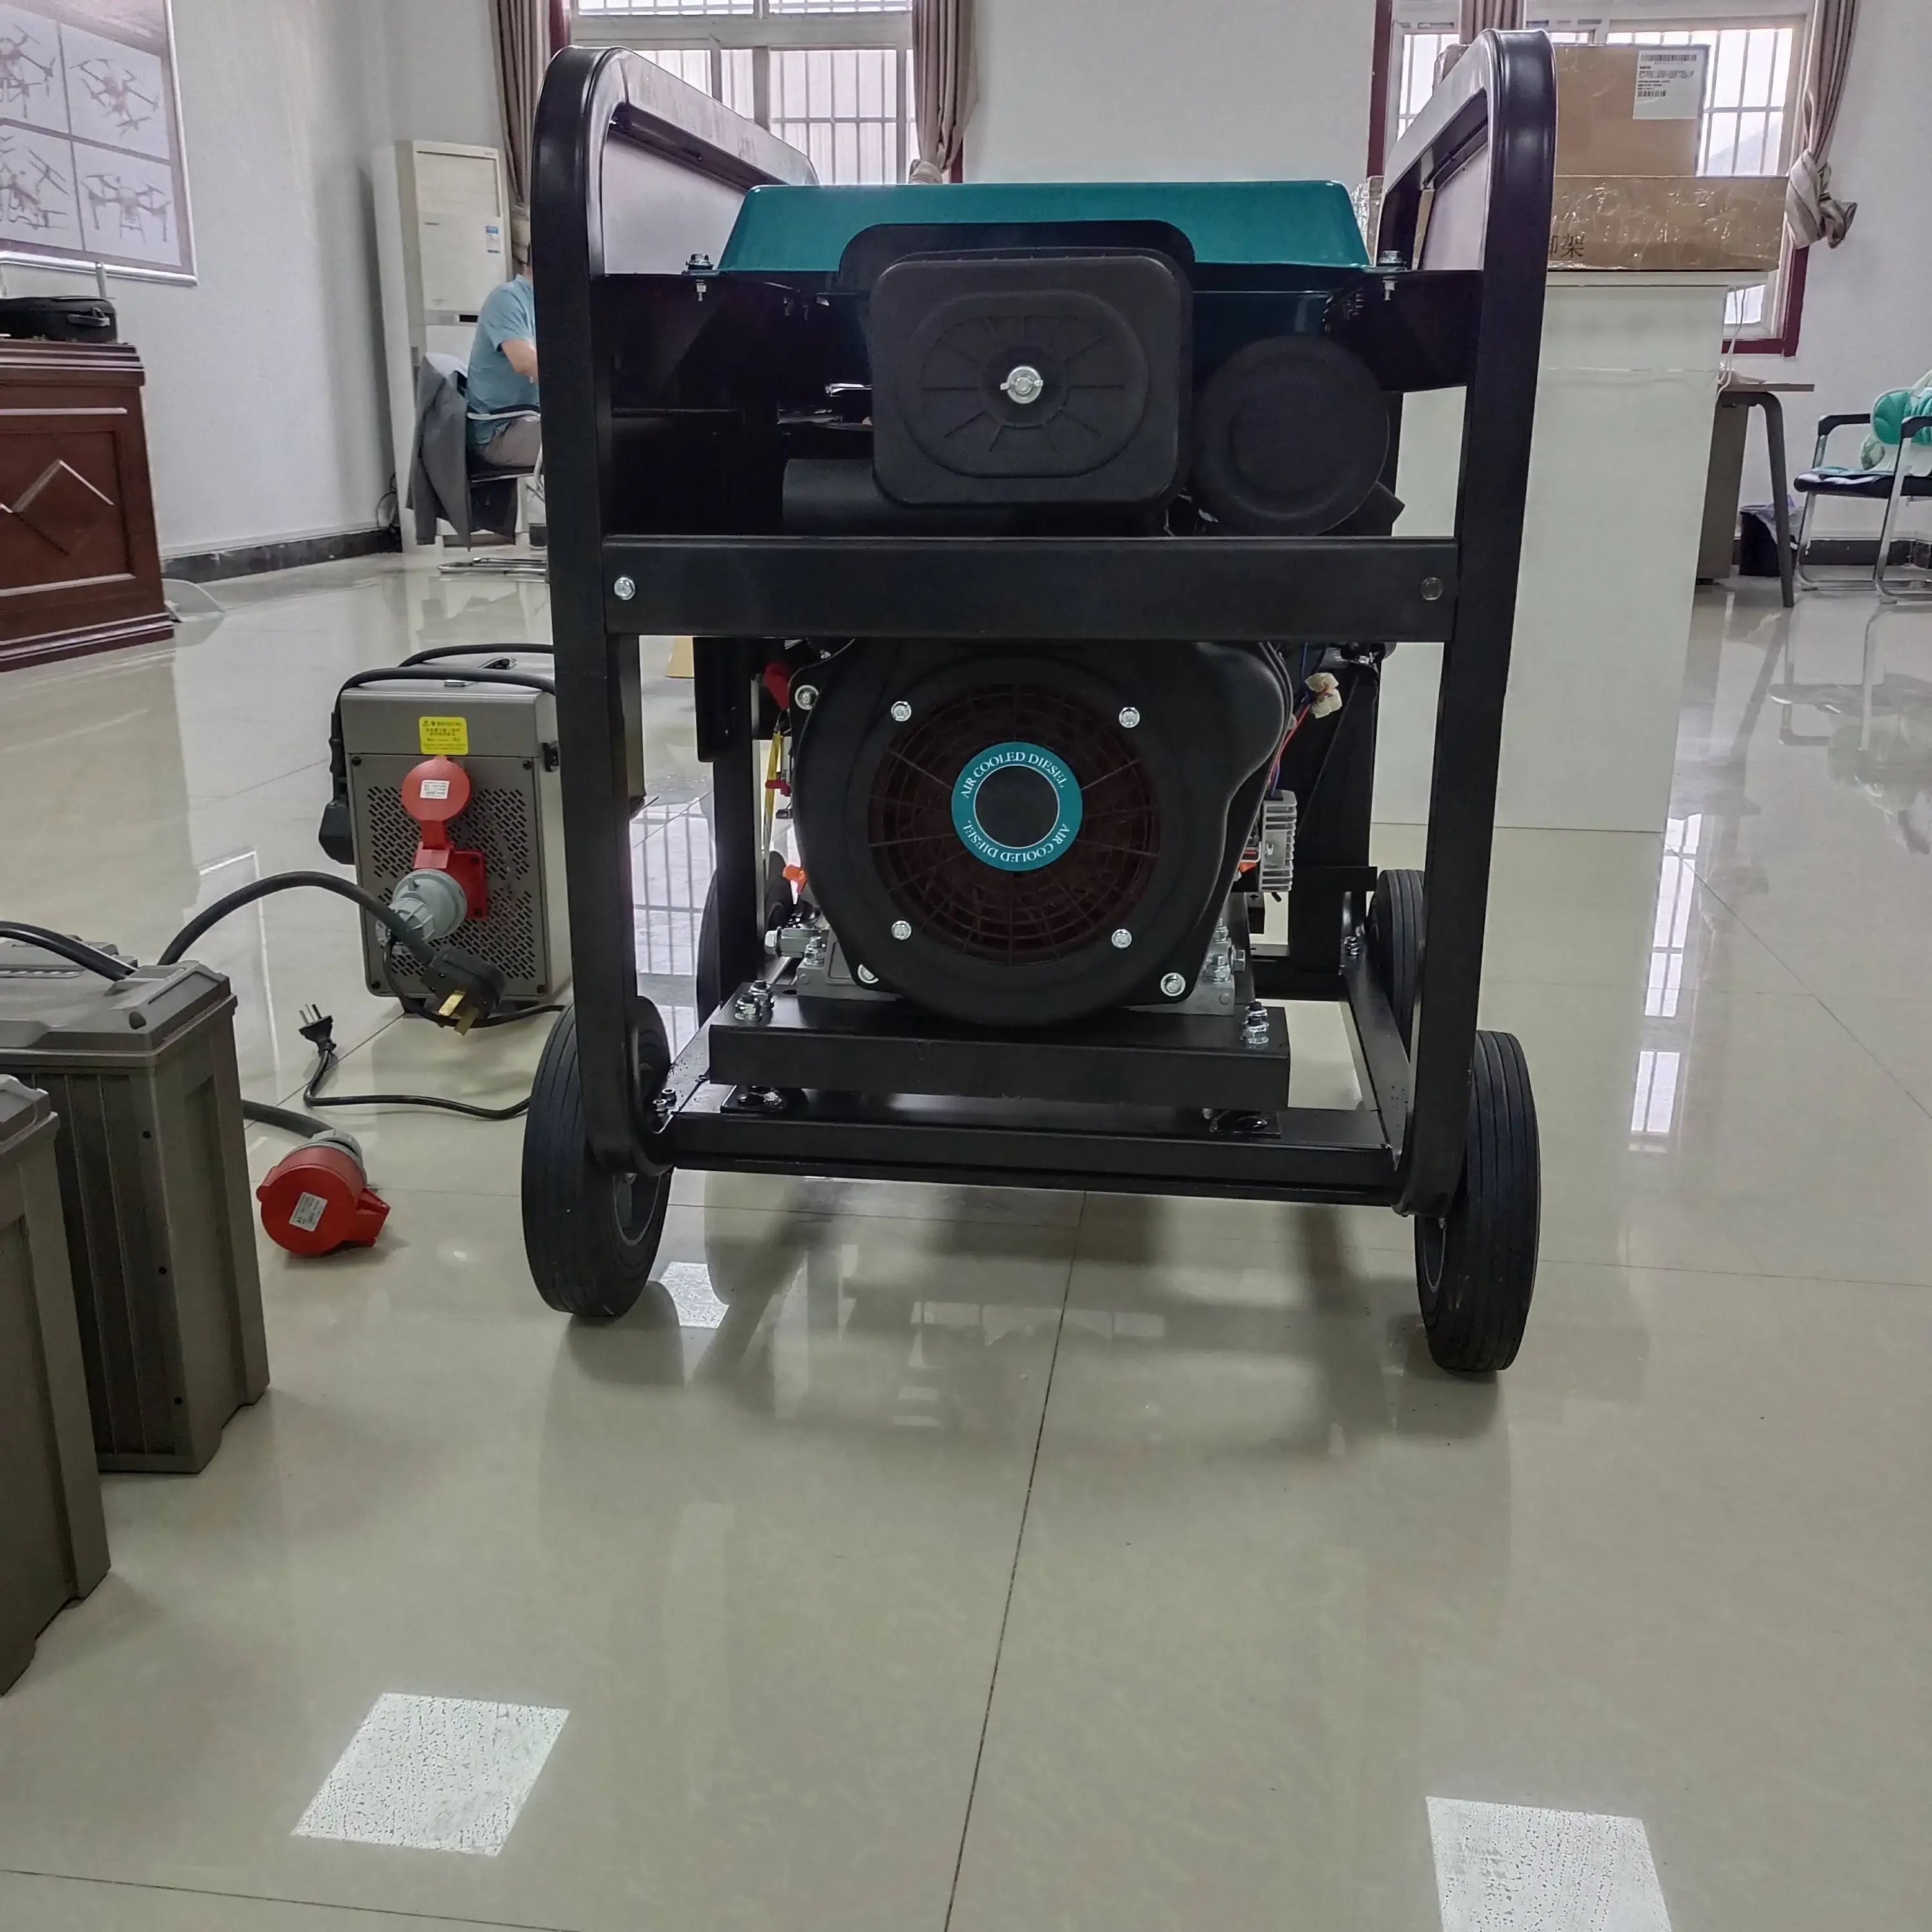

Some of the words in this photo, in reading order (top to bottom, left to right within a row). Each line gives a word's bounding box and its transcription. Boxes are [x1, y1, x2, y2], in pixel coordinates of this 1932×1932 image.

[960, 777, 977, 799] AIR
[973, 752, 1026, 777] COOLED
[1028, 753, 1068, 788] DIESEL
[963, 820, 999, 858] DIESEL
[1052, 823, 1070, 844] AIR
[999, 843, 1054, 862] COOLED
